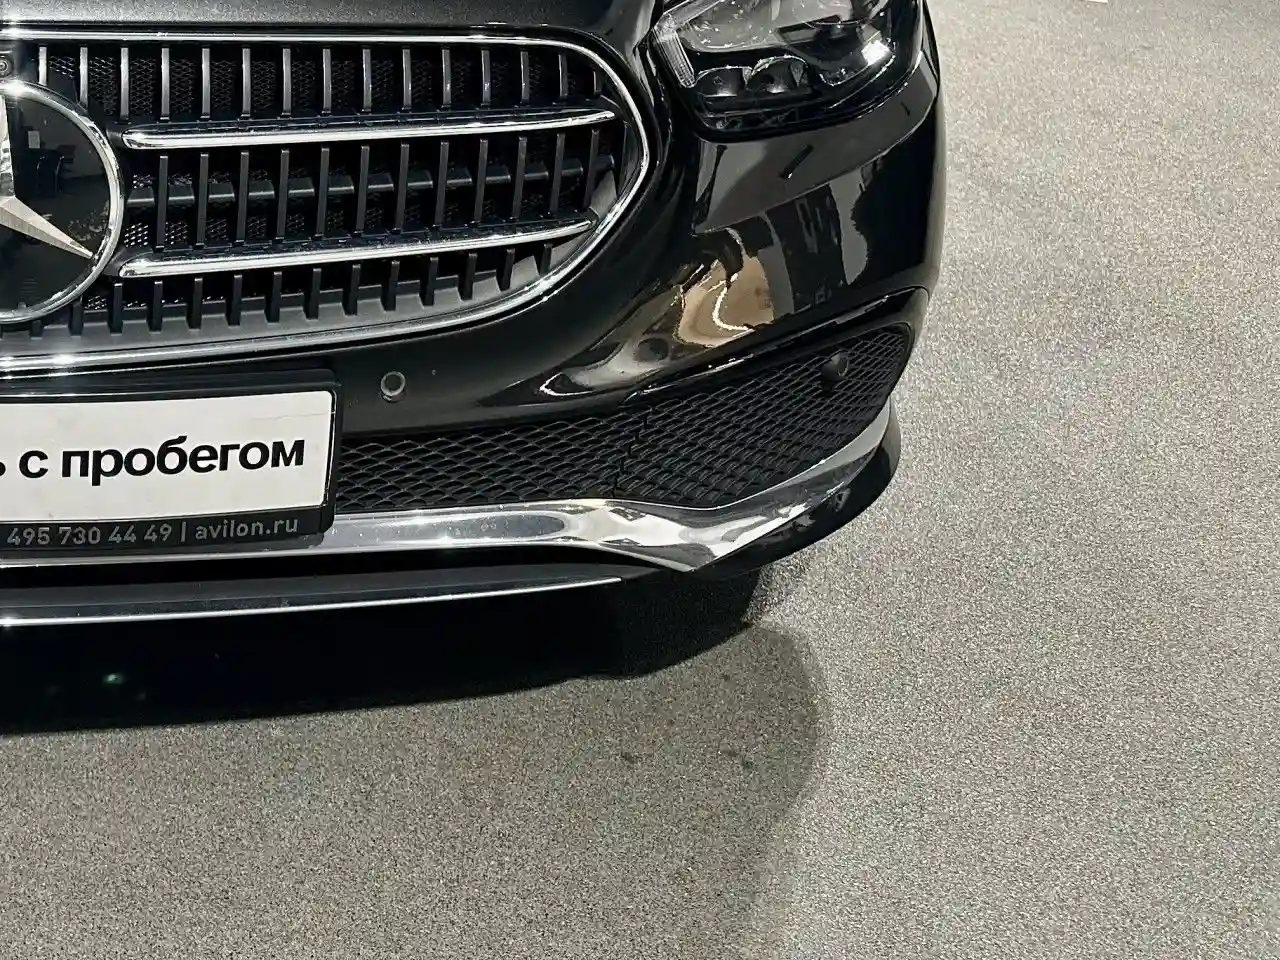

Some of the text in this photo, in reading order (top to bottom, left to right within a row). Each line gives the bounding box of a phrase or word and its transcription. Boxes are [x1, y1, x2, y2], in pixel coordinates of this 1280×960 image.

[18, 447, 50, 479] с
[61, 435, 306, 487] пробегом
[6, 526, 50, 546] 495
[58, 525, 101, 545] 730
[108, 525, 137, 544] 44
[144, 523, 172, 543] 49
[195, 517, 300, 541] avilon.ru
